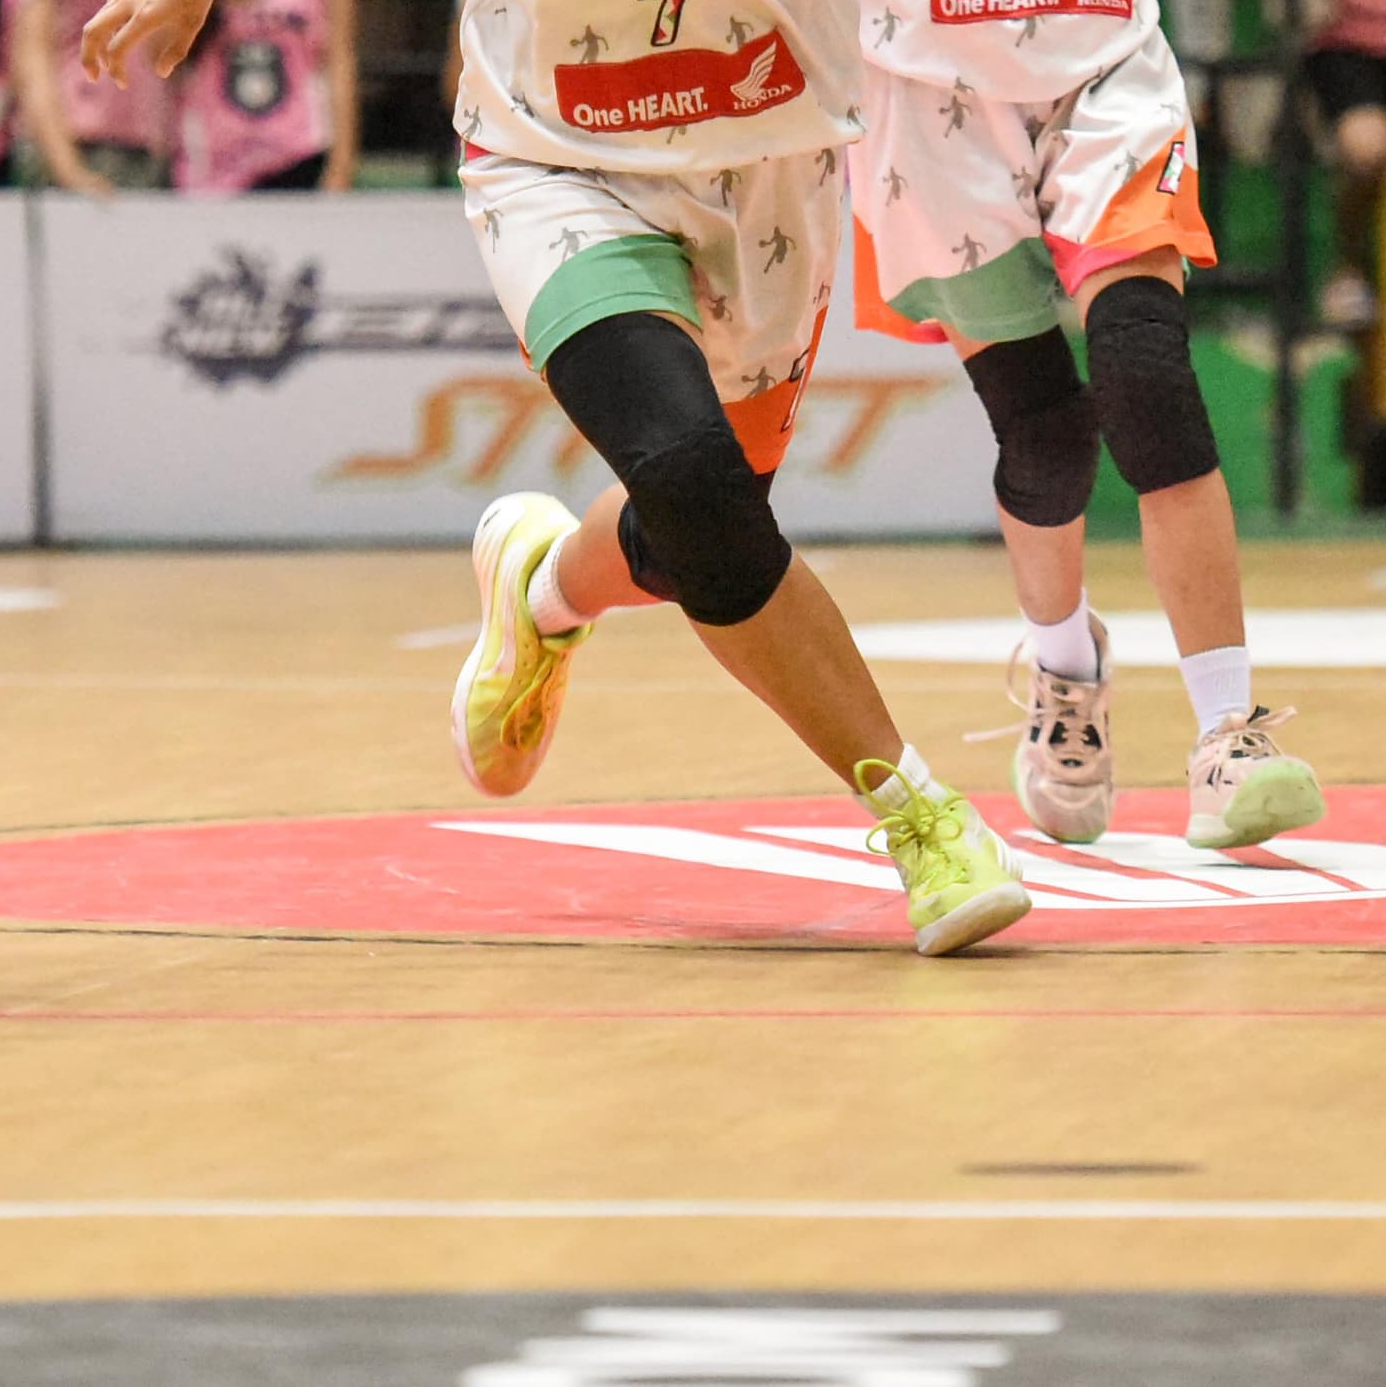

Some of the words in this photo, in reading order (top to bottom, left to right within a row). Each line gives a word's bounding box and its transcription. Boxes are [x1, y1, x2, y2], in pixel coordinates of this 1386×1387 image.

[573, 103, 624, 127] One
[627, 86, 709, 124] HEART.
[732, 84, 793, 111] HONDA
